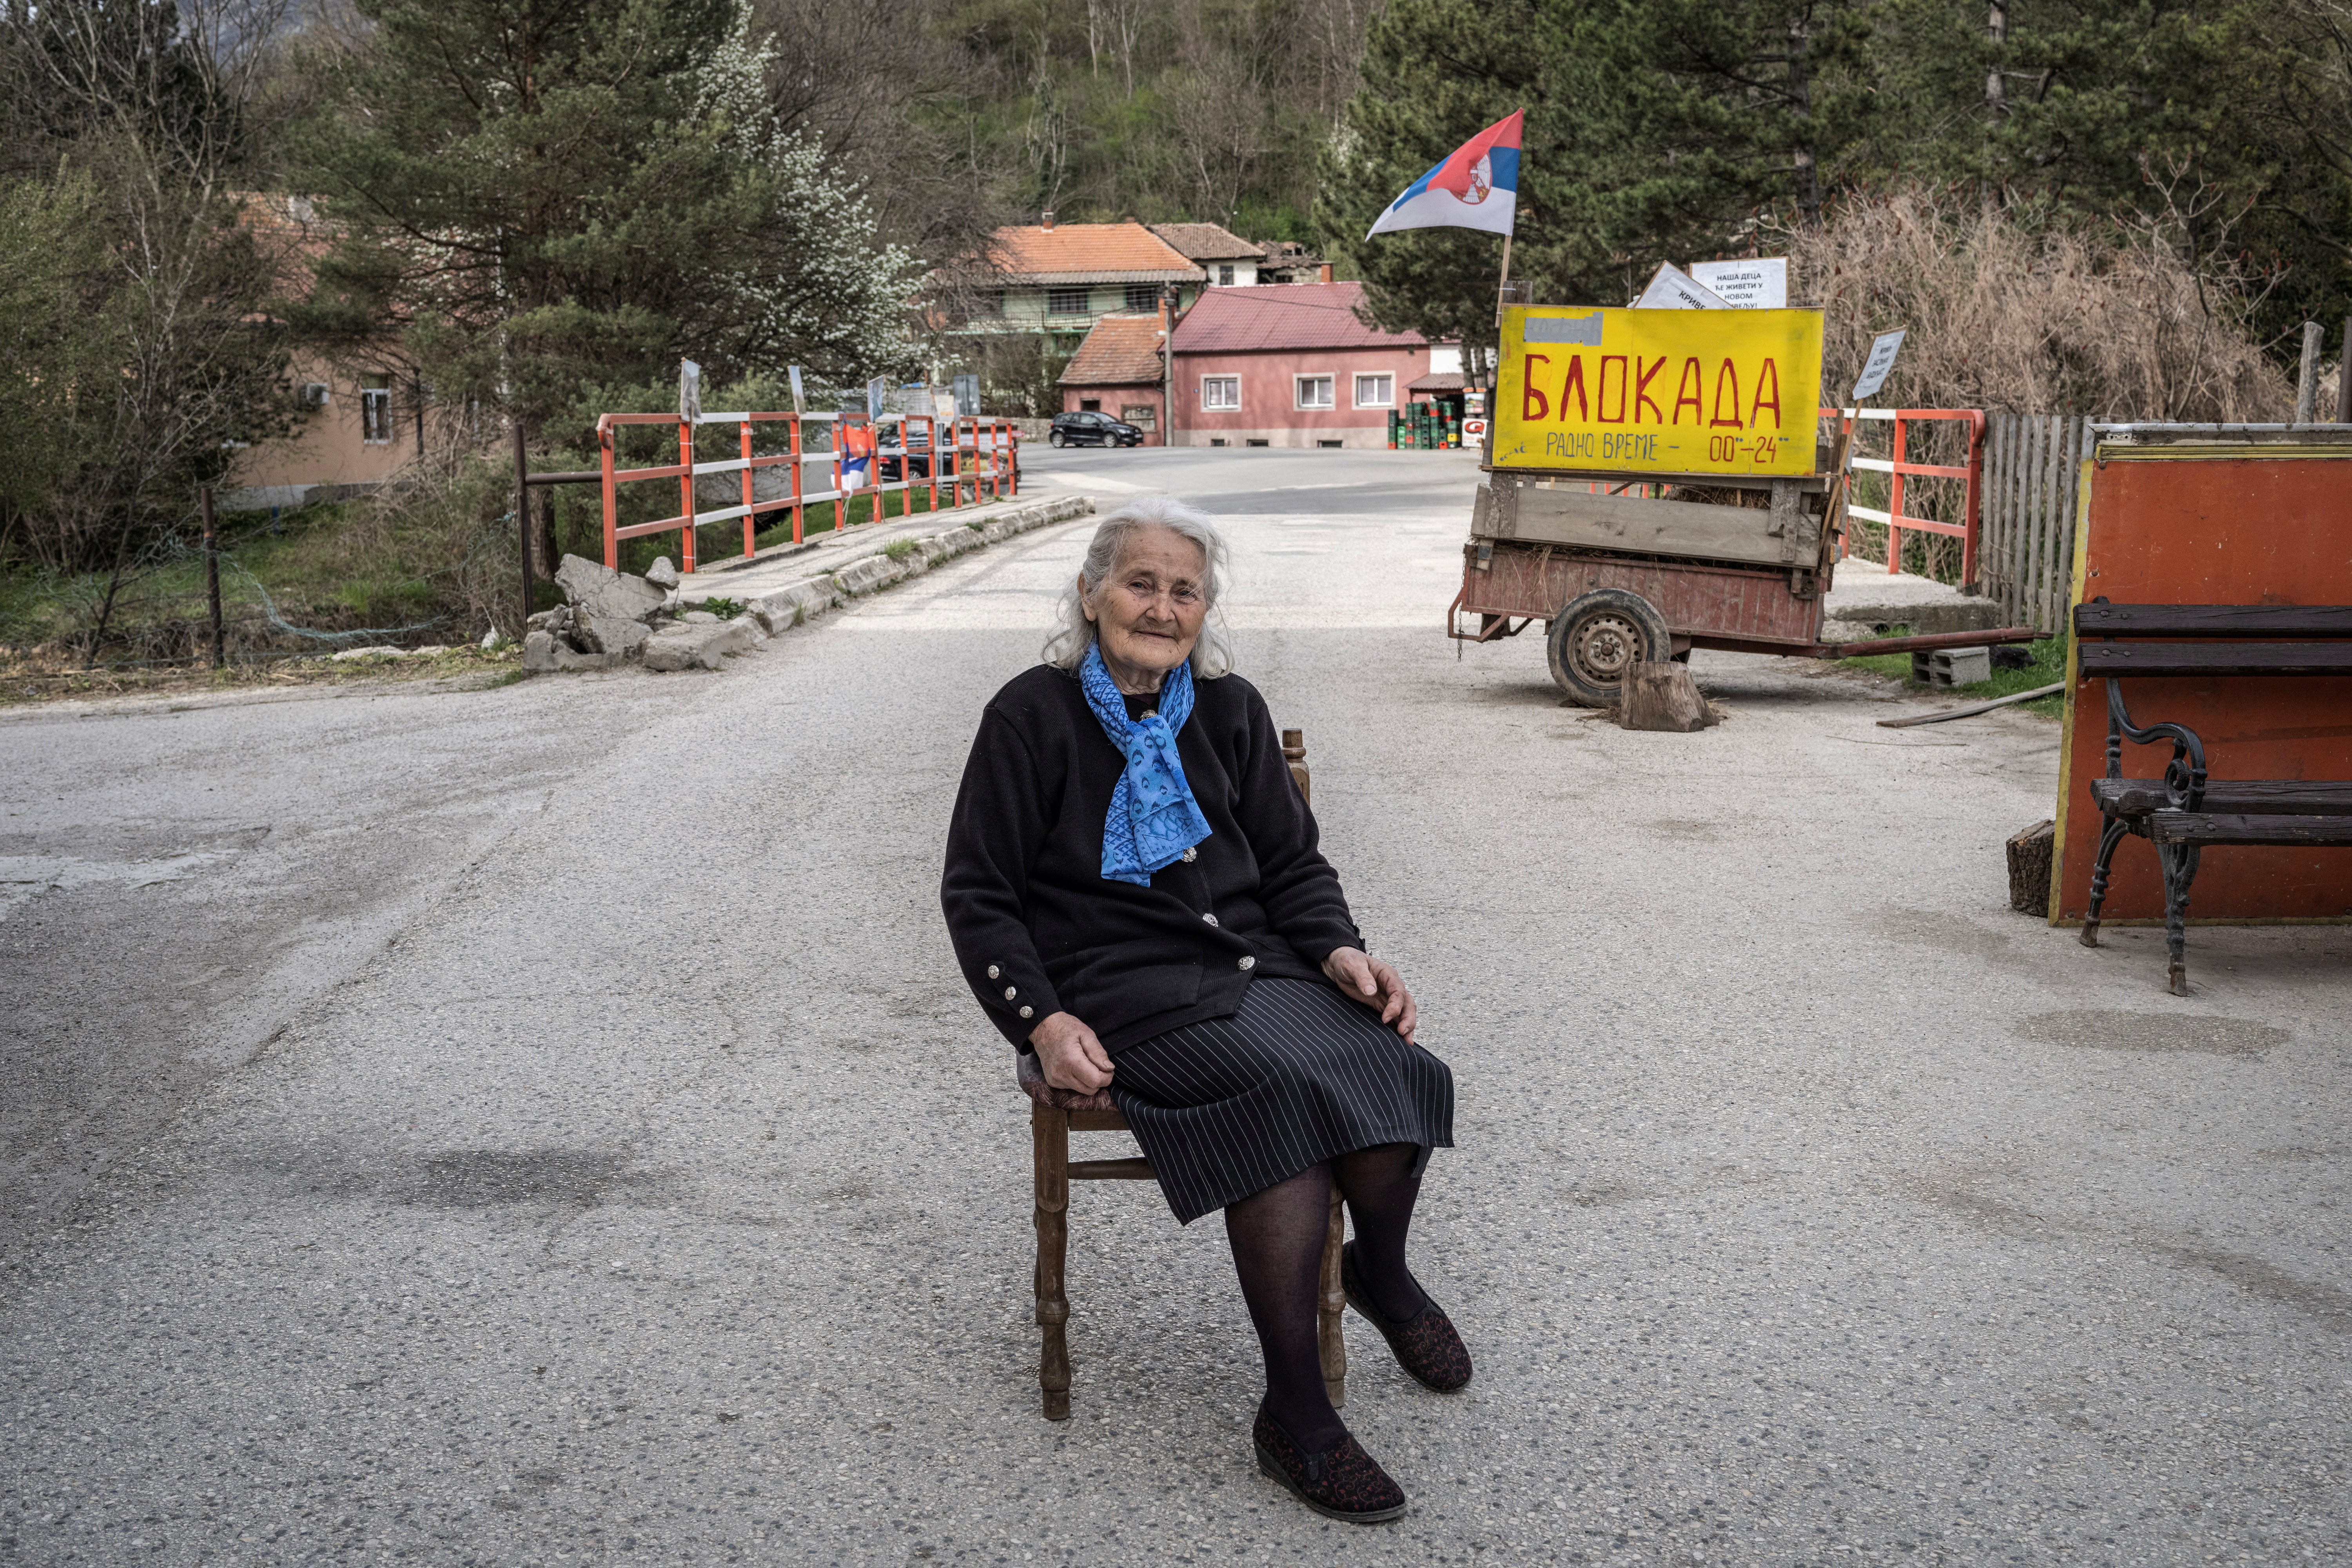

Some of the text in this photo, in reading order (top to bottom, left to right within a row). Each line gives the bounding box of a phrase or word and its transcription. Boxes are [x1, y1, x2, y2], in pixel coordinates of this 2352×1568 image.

[1523, 354, 1780, 431] БЛОКАДА
[1546, 432, 1594, 457] РАДНО
[1603, 433, 1658, 461] ВРЕМЕ
